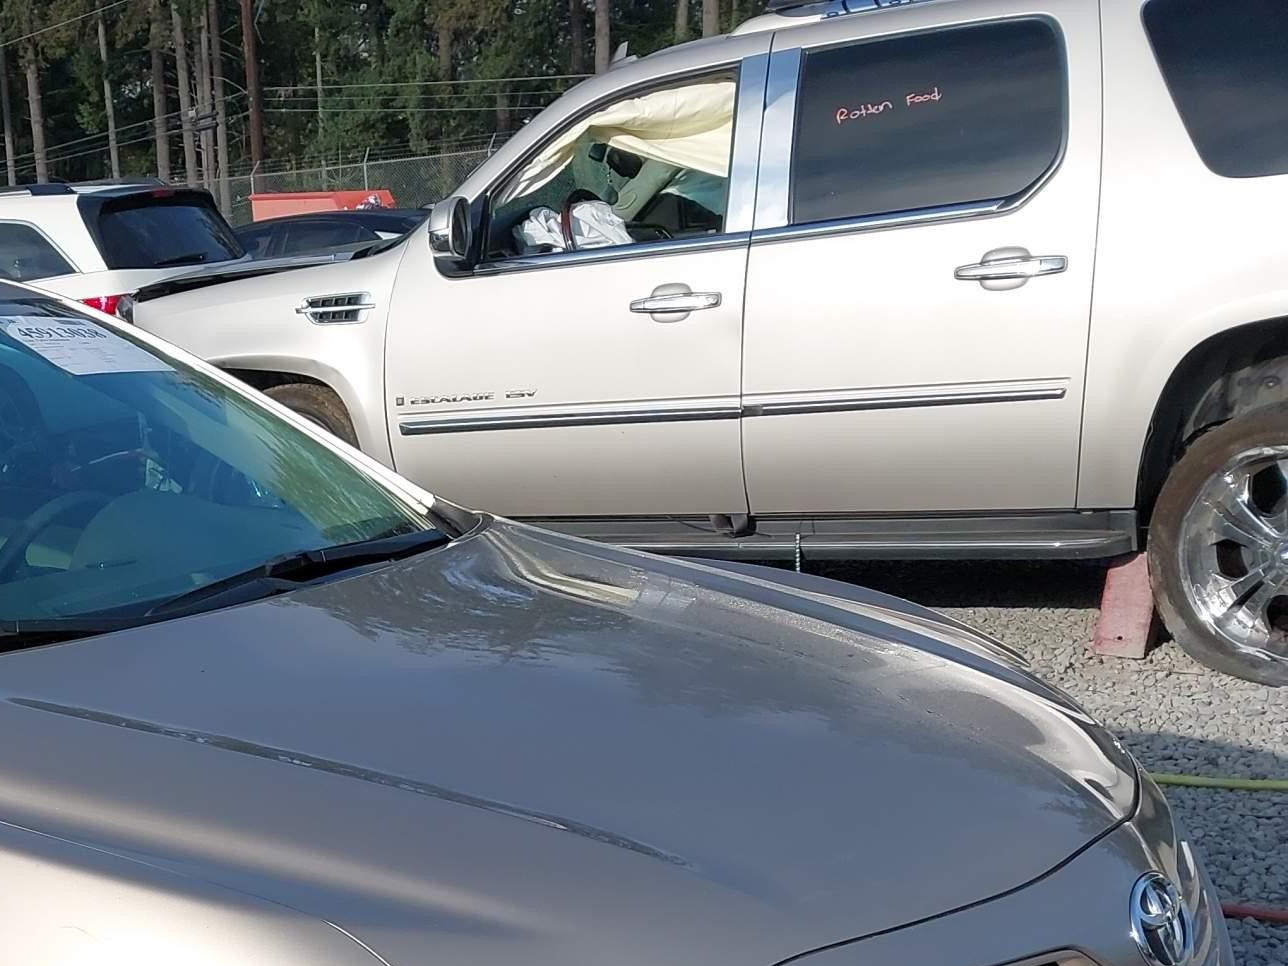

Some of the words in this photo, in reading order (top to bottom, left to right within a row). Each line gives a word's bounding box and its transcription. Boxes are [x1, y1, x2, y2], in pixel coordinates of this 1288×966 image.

[836, 101, 892, 124] Rotten
[906, 87, 942, 106] Food
[17, 327, 107, 339] 45913038
[410, 392, 495, 405] ESCALADE
